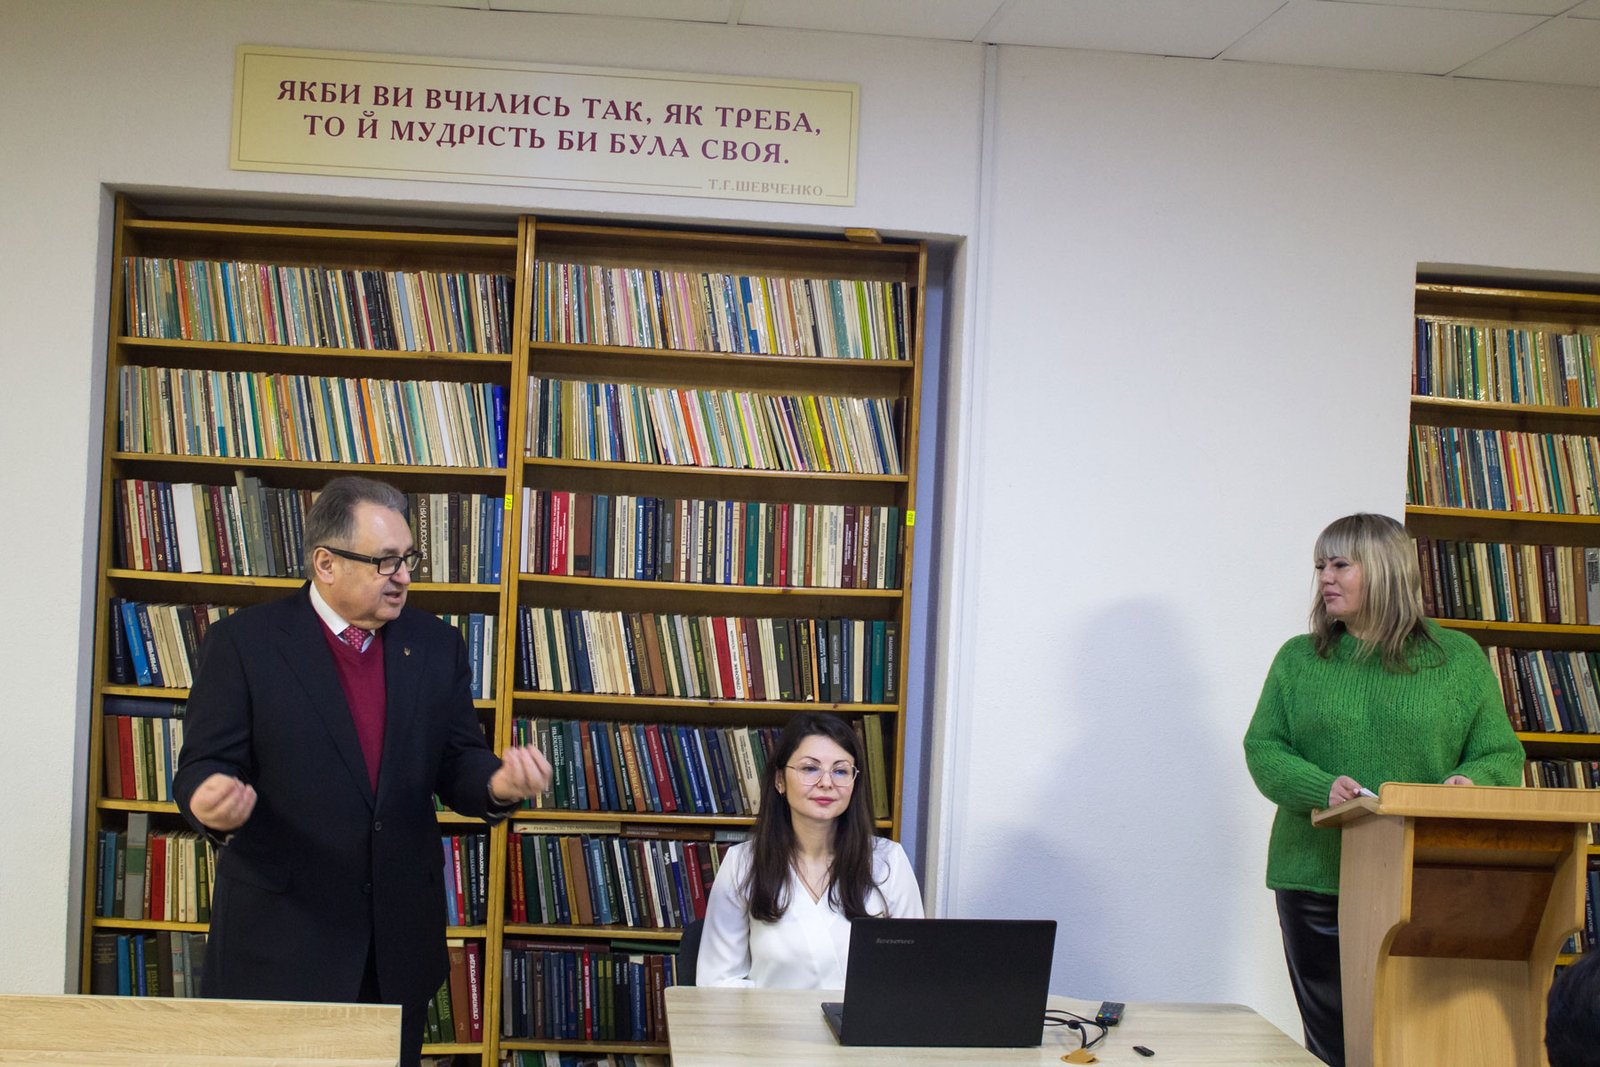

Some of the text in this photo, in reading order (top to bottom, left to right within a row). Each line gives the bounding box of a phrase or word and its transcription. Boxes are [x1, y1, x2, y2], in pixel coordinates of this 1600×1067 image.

[277, 79, 823, 137] ЯКБИ ВИ ВЧИЛИСЬ ТАК, ЯК ТРЕБА,
[303, 110, 791, 165] ТО Й МУДРІСТЬ БИ БУЛА СВОЯ.
